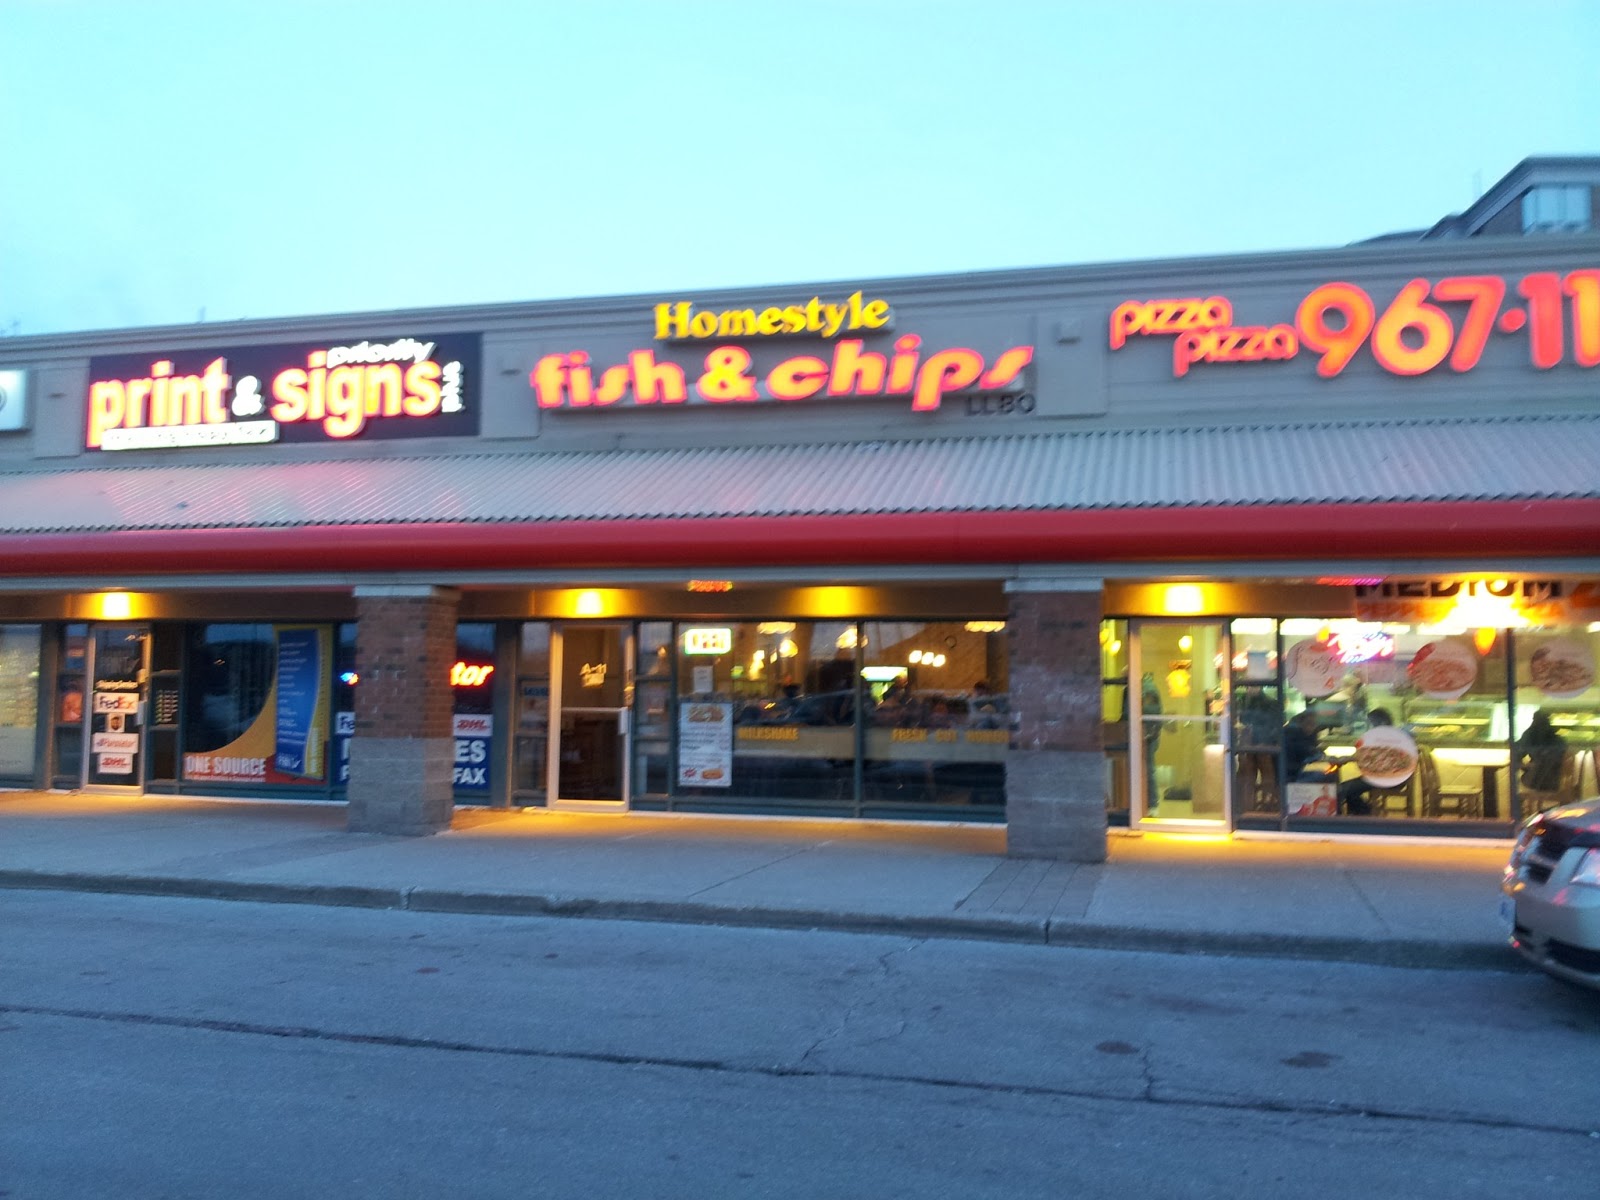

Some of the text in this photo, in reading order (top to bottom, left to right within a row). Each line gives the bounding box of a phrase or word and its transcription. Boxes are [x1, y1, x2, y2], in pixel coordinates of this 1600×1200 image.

[653, 290, 892, 340] Homestyle
[1110, 295, 1233, 350] pizza
[530, 333, 1035, 412] fish & chips
[1172, 323, 1299, 378] pizza
[86, 349, 445, 449] print & signs
[967, 393, 1036, 416] LLBO
[99, 695, 136, 709] FedEx
[457, 719, 490, 732] DHL
[184, 756, 212, 774] ONE
[214, 757, 267, 775] SOURCE
